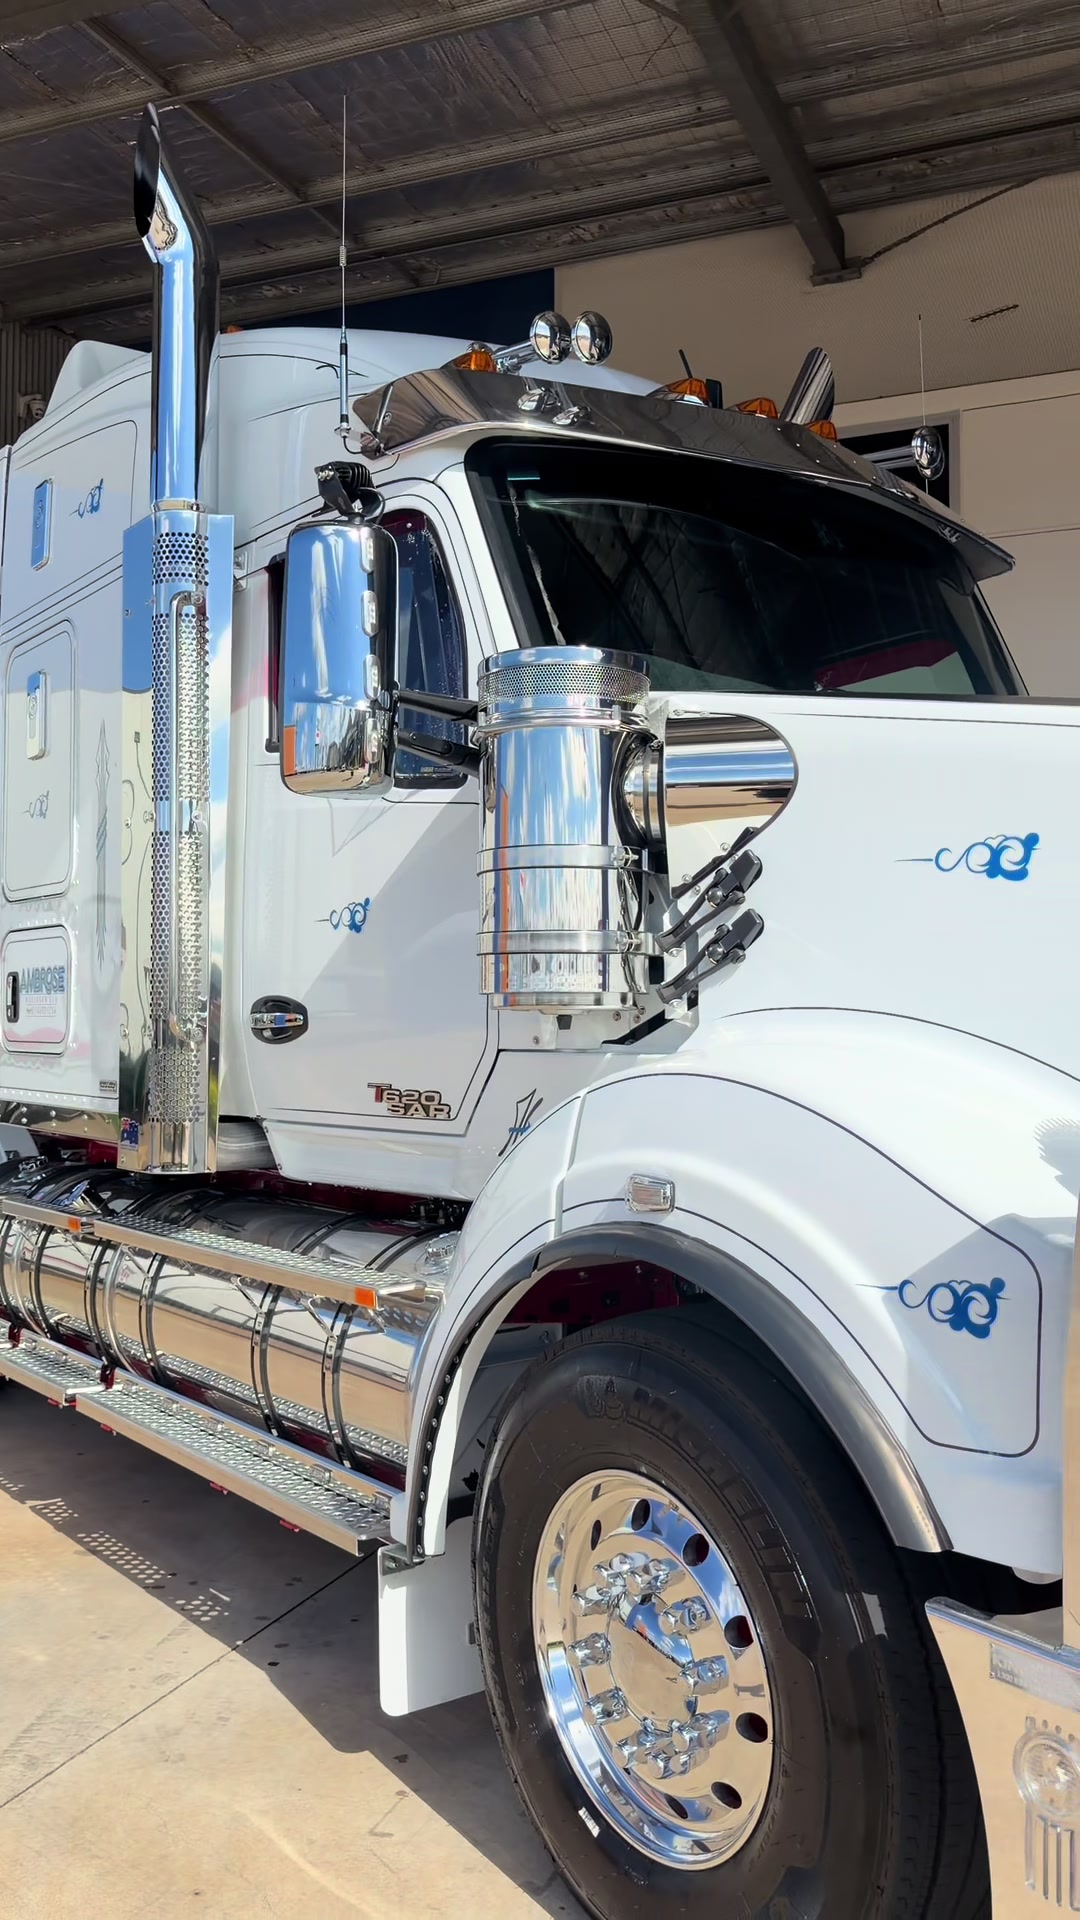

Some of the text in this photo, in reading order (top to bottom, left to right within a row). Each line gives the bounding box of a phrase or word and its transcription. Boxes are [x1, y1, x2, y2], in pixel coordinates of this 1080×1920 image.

[20, 966, 65, 995] AMBROSE
[367, 1082, 442, 1105] T620
[387, 1102, 451, 1119] SAR
[627, 1386, 816, 1621] MICHELIN
